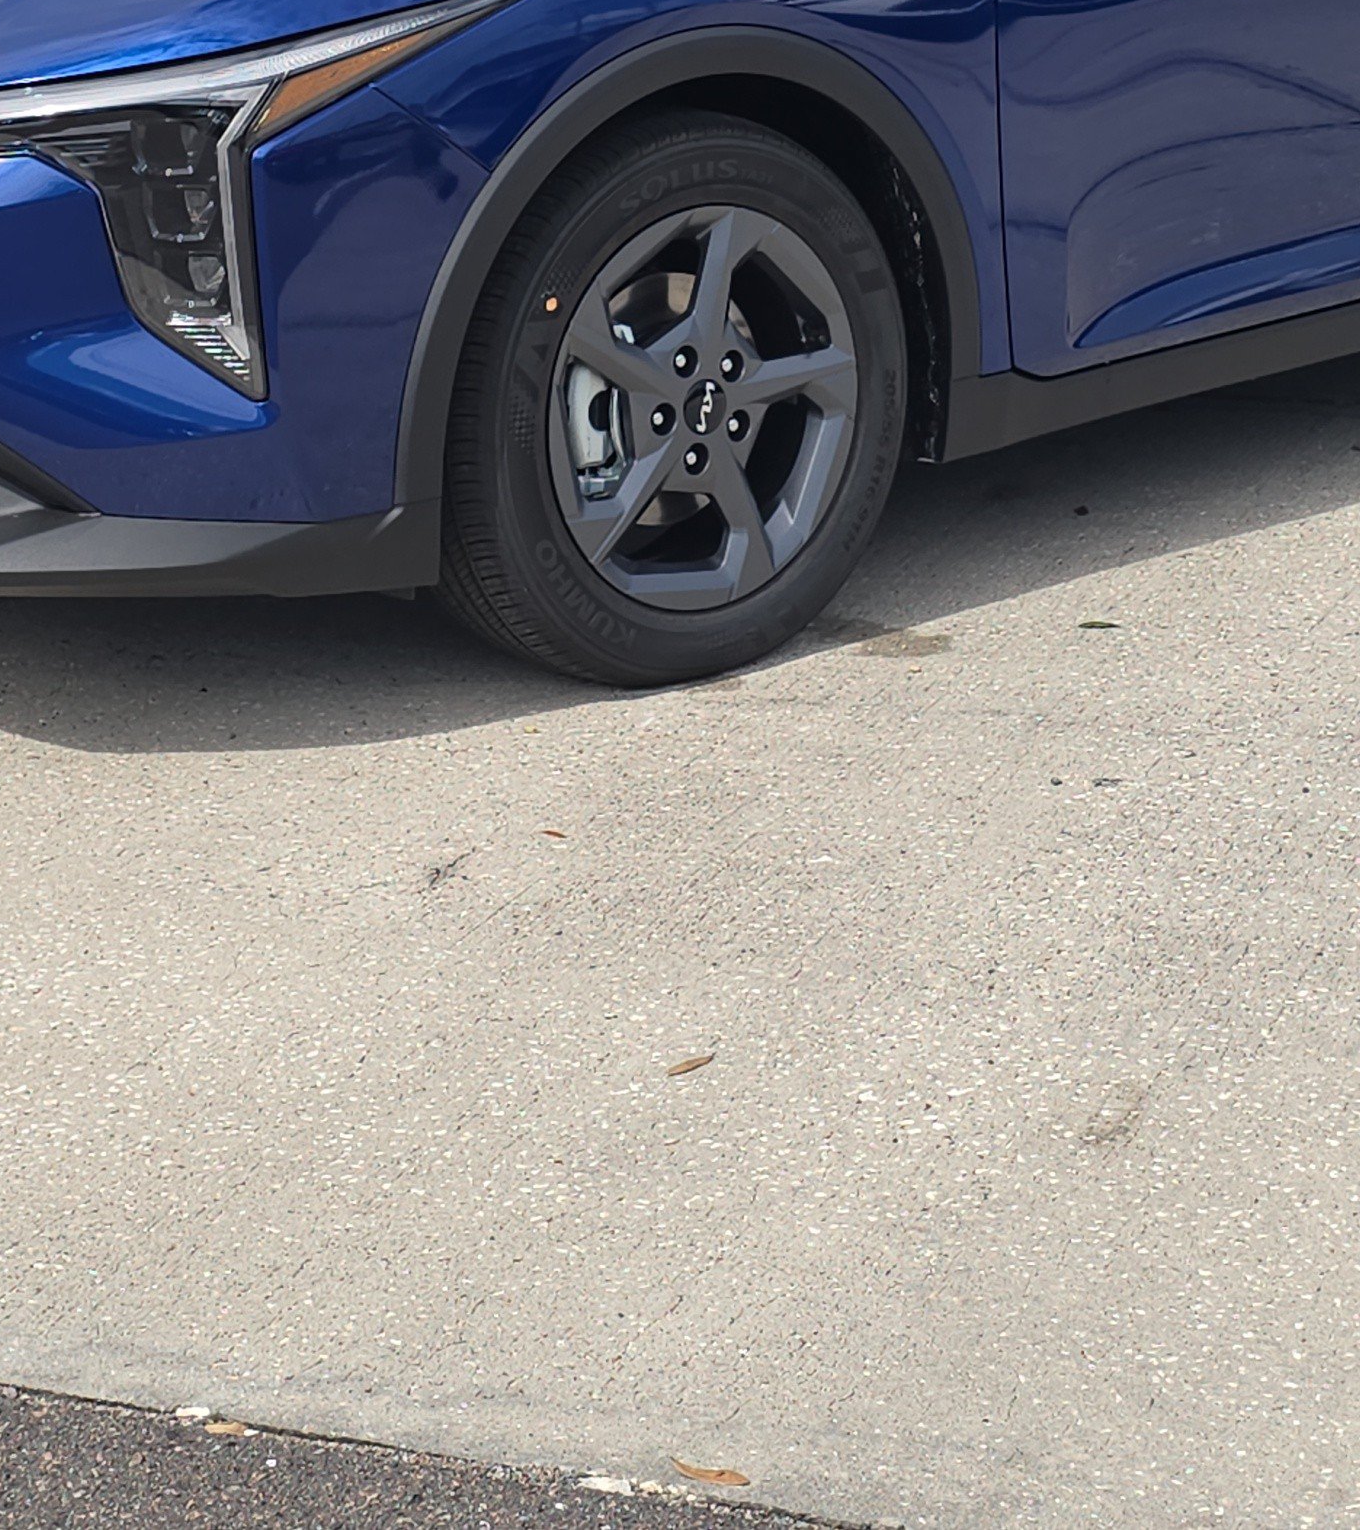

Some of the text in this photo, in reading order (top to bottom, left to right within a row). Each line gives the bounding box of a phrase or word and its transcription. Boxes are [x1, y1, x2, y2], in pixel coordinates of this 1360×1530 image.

[618, 158, 739, 212] SOLUS
[696, 381, 715, 433] KIA
[536, 538, 638, 650] KUMHO
